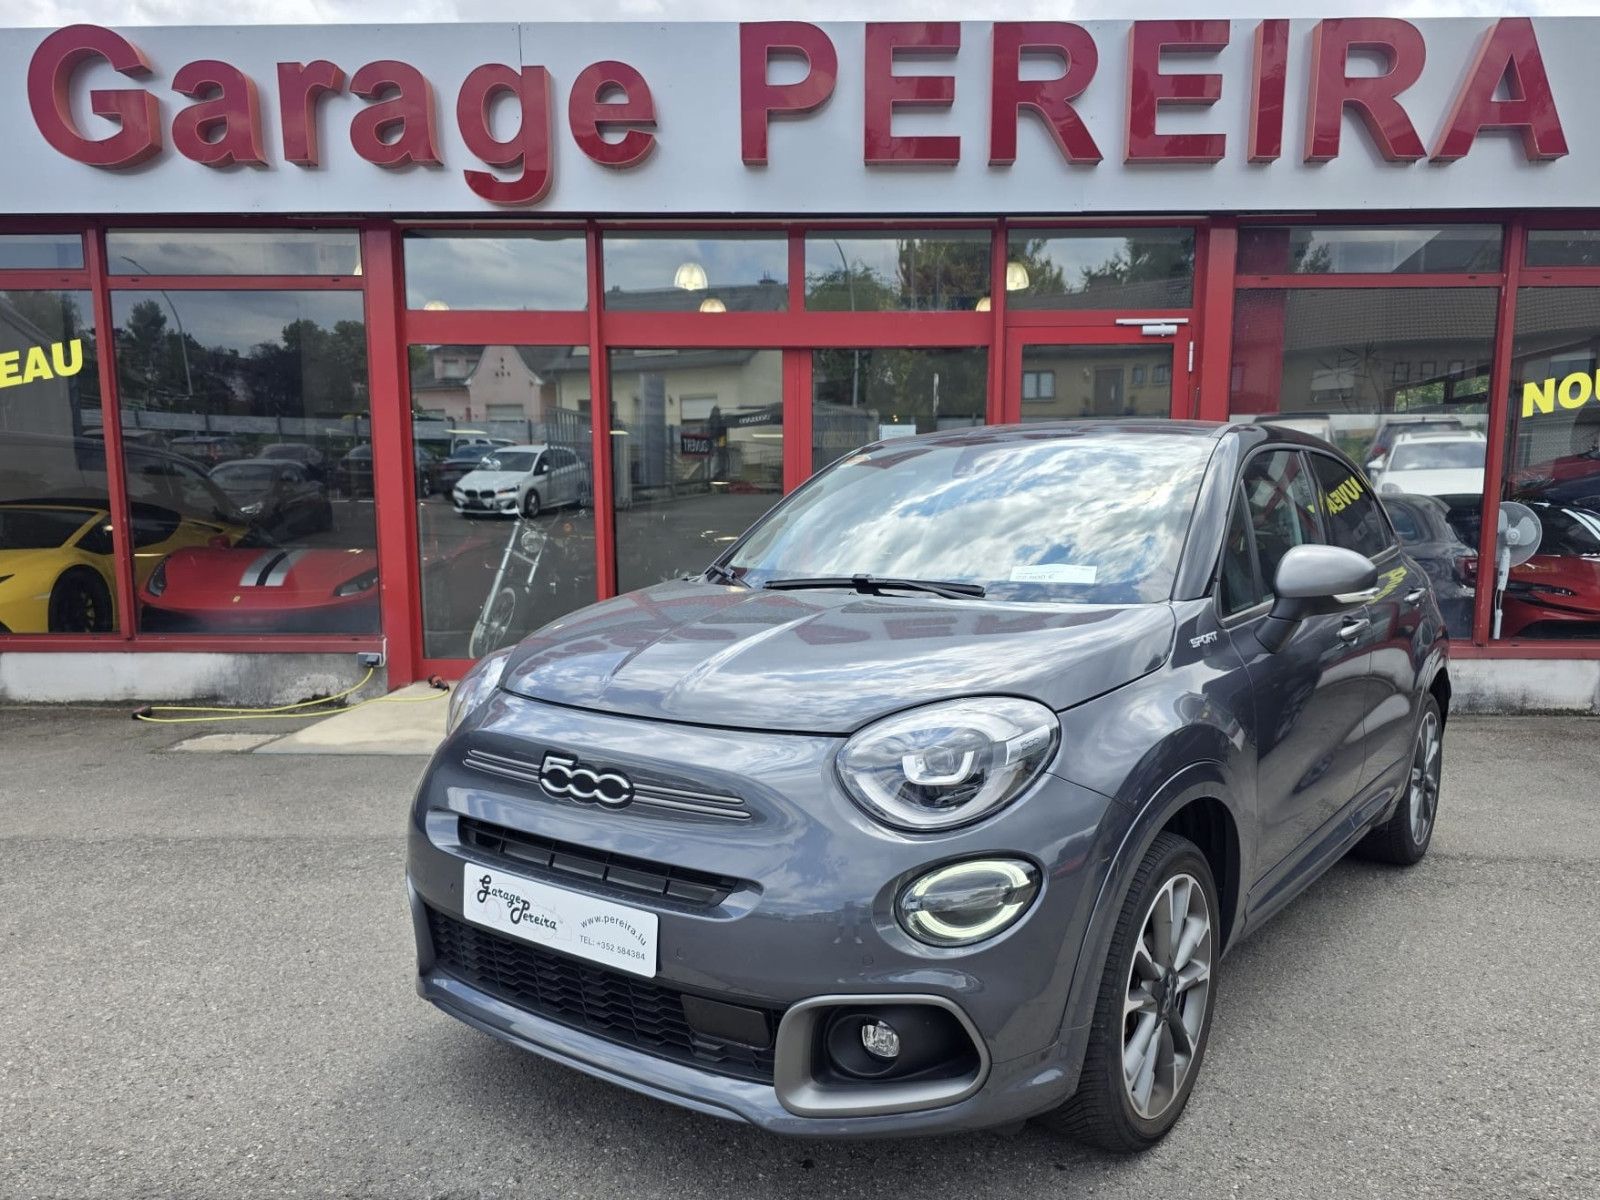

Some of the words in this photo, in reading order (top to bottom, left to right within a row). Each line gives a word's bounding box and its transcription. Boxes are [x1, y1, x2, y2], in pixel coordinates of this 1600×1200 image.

[27, 23, 656, 206] Garage
[739, 16, 1569, 167] PEREIRA
[0, 338, 83, 389] EAU
[1521, 368, 1600, 419] NO
[1189, 630, 1218, 649] SPORT
[541, 755, 631, 804] 500
[477, 874, 522, 909] Garage
[510, 899, 557, 931] Pereira
[580, 915, 648, 947] www.pereira.lu
[579, 935, 596, 947] TEL:
[596, 941, 616, 953] +352
[617, 946, 647, 961] 584384
